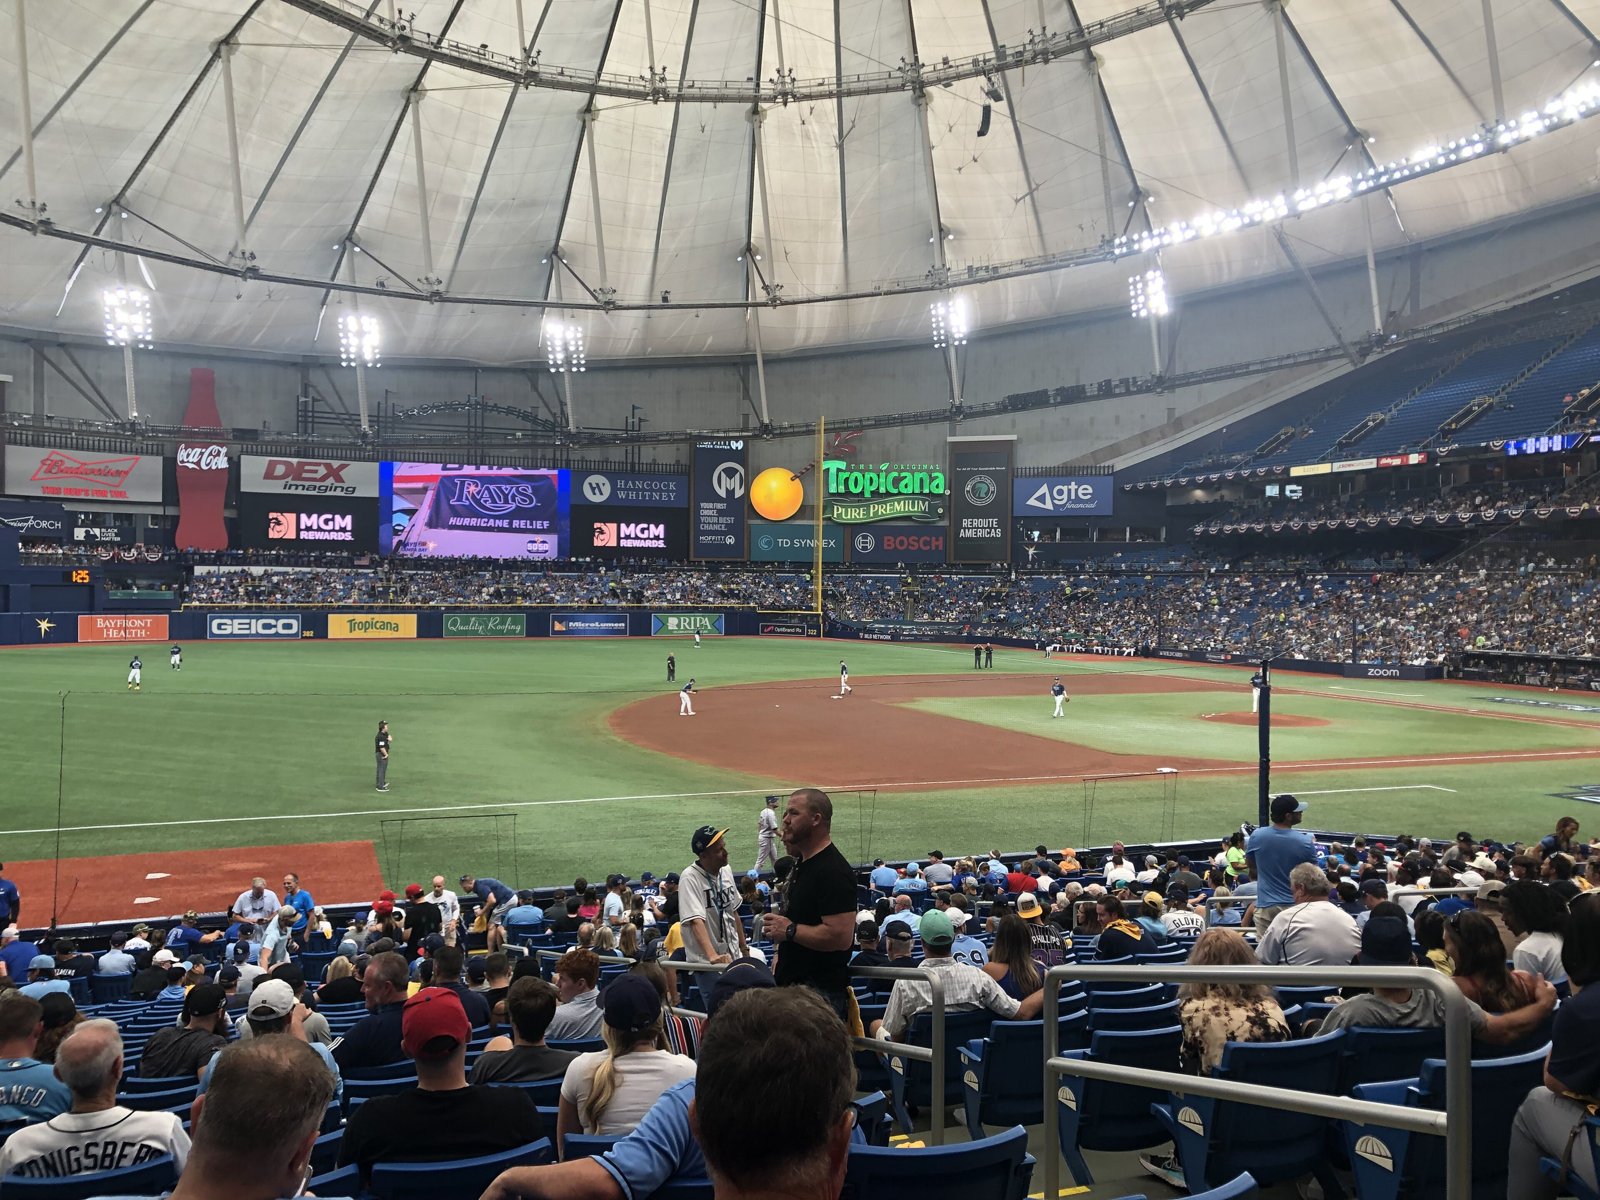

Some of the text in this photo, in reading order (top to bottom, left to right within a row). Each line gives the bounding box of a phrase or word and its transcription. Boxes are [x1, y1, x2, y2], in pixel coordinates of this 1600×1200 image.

[177, 443, 228, 471] Coca-Cola
[40, 458, 129, 478] Budweiser
[263, 459, 351, 484] DEX
[617, 479, 677, 491] HANCOCK
[822, 460, 945, 498] Tropicana
[283, 482, 357, 495] imaging
[1053, 481, 1093, 506] gte
[617, 491, 676, 501] WHITNEY
[833, 500, 929, 520] PURE PREMIUM
[1060, 500, 1098, 512] financial
[29, 520, 62, 529] PORCH
[300, 513, 351, 531] MGM
[448, 517, 550, 529] HURRICANE RELIEF
[962, 518, 999, 528] REROUTE
[620, 523, 665, 540] MGM
[959, 528, 1002, 538] AMERICAS
[777, 539, 791, 548] TD
[883, 535, 944, 551] BOSCH
[72, 570, 90, 583] 1:25
[211, 619, 299, 635] GEICO
[346, 618, 400, 634] Tropicana
[447, 616, 522, 633] Quality Roofing
[680, 617, 712, 630] RIPA
[1367, 668, 1400, 676] zoom
[1172, 916, 1204, 930] GLOVER
[1031, 935, 1061, 946] PHILLIPS
